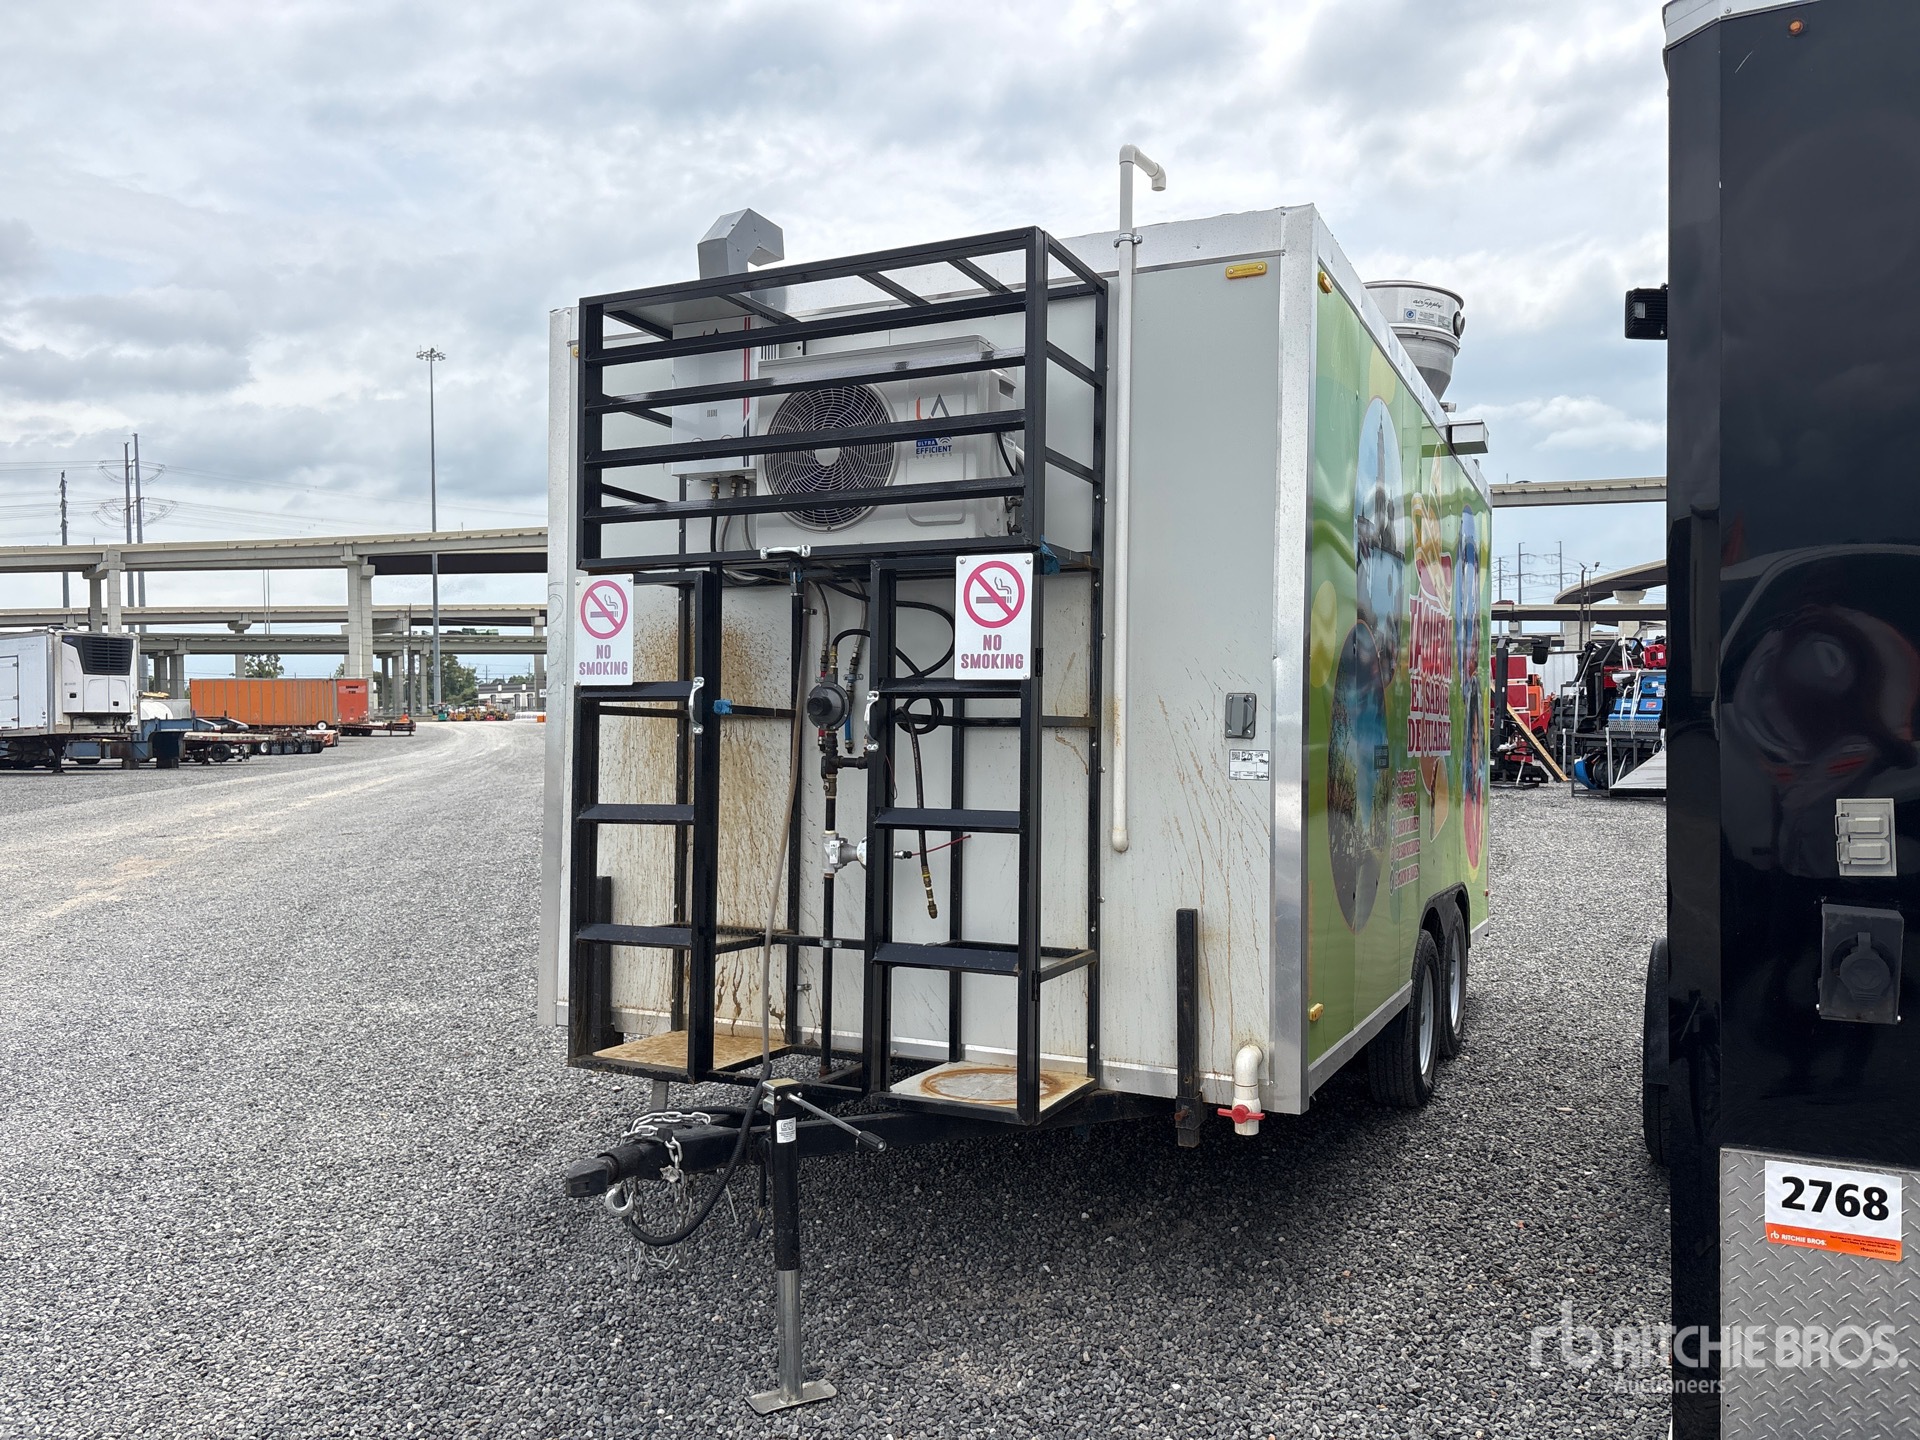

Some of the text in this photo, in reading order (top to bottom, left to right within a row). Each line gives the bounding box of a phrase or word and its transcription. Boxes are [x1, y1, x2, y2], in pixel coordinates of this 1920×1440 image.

[916, 445, 952, 455] EFFICIENT
[983, 634, 1002, 651] NO
[596, 644, 611, 659] NO
[579, 661, 628, 675] SMOKING
[961, 653, 1024, 669] SMOKING
[1425, 681, 1450, 716] SABOR
[1408, 718, 1422, 752] DE
[1781, 1176, 1889, 1221] 2768
[1781, 1233, 1806, 1243] RITCHIE
